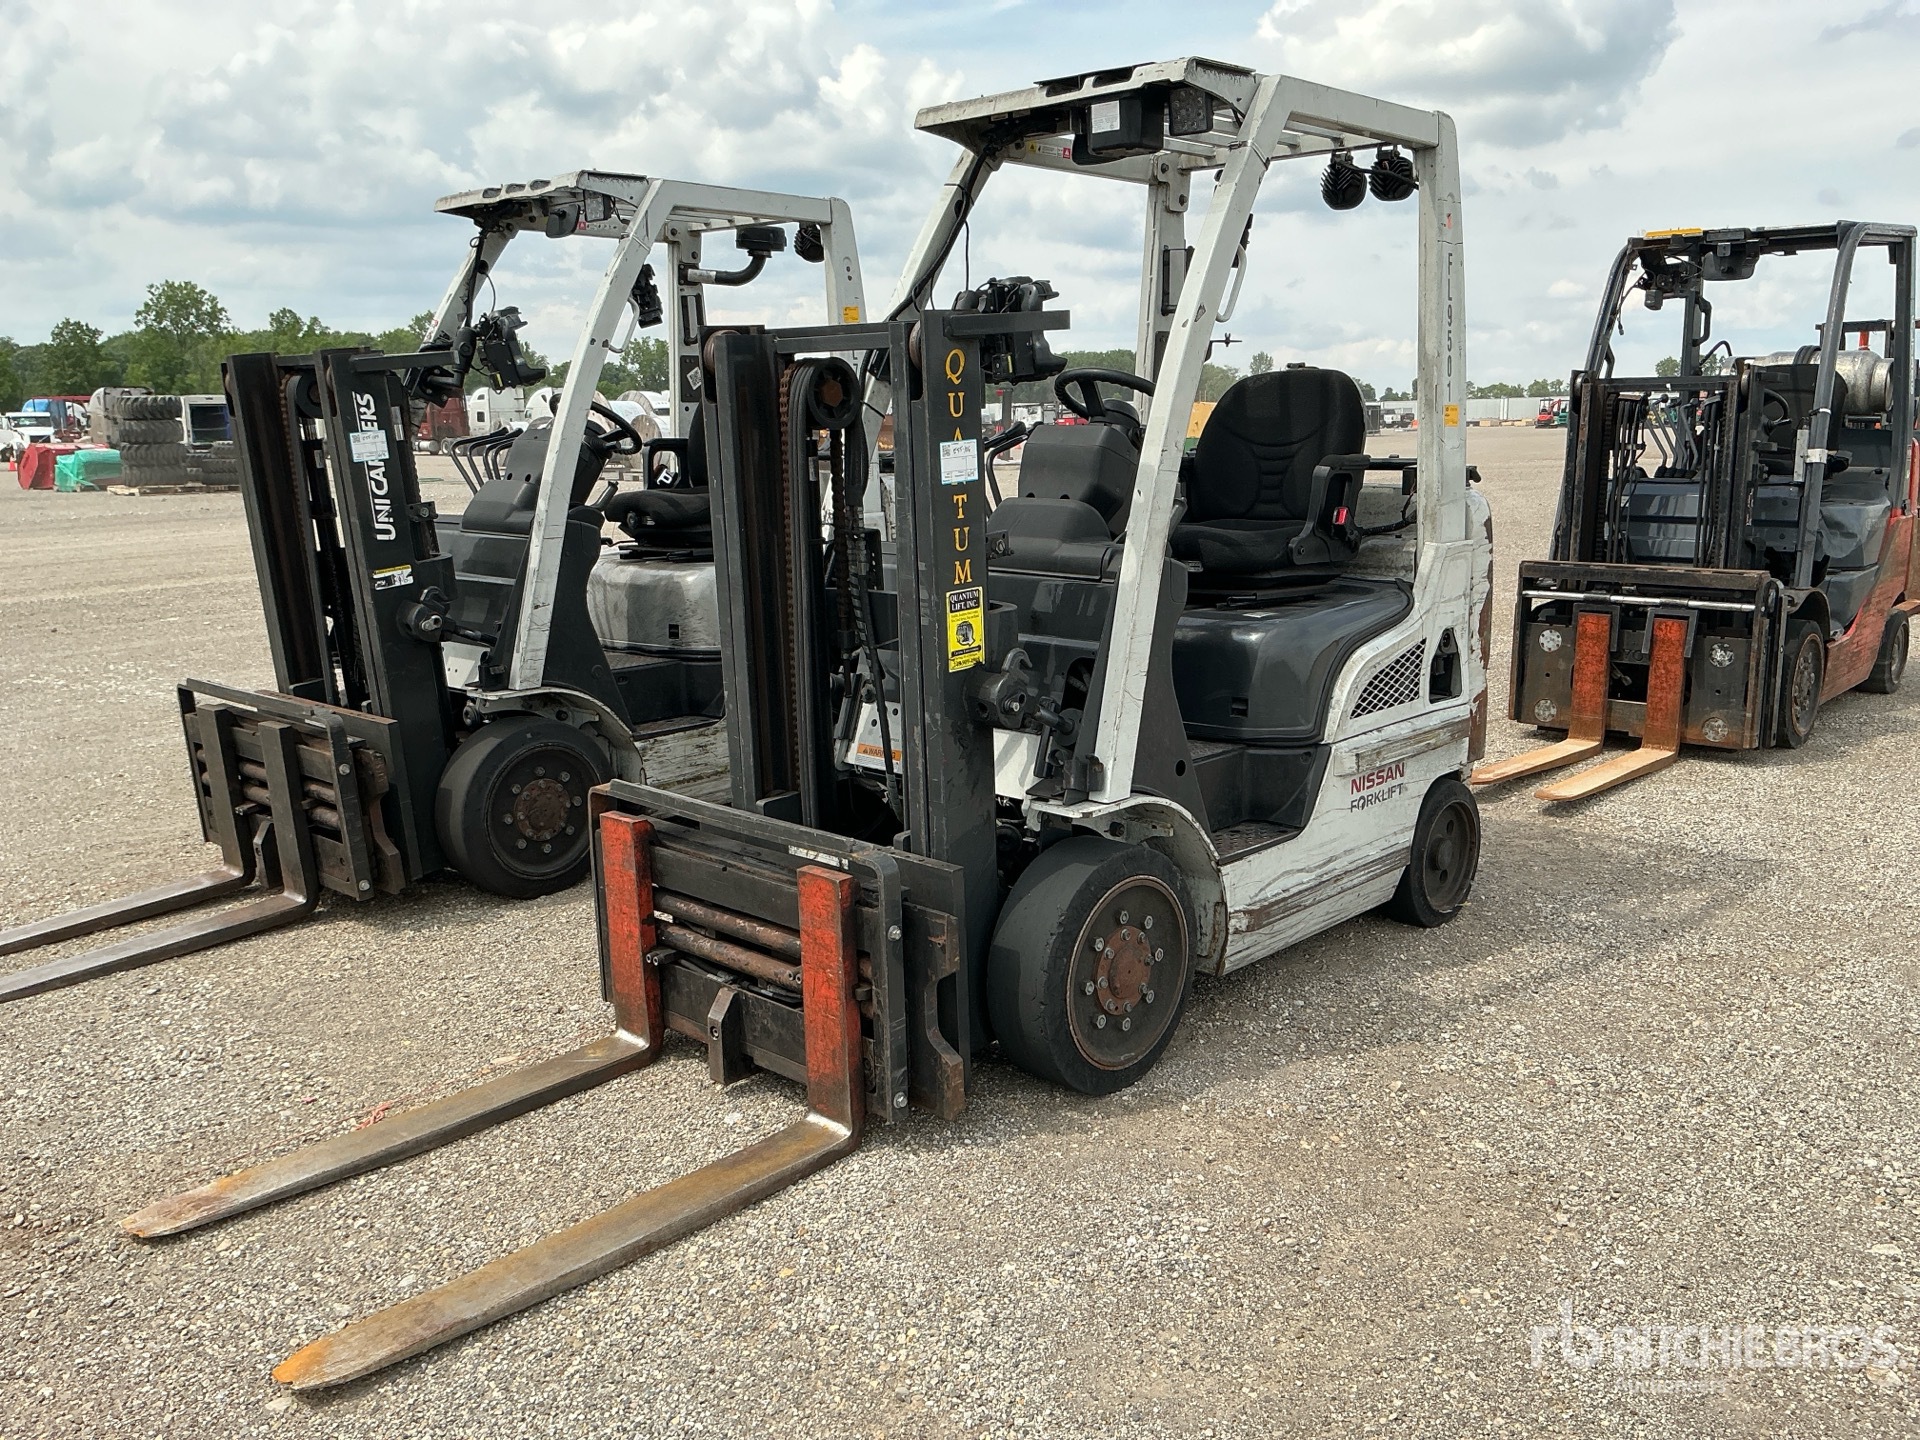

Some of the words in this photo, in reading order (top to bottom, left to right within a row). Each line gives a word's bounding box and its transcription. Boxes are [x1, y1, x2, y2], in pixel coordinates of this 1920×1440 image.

[356, 392, 397, 541] UNICAERS
[945, 348, 972, 585] QUTUM
[950, 590, 979, 603] QUANTUM
[967, 599, 978, 609] INC.
[1351, 762, 1405, 795] NISSAN
[1350, 783, 1404, 813] FORKLIFT
